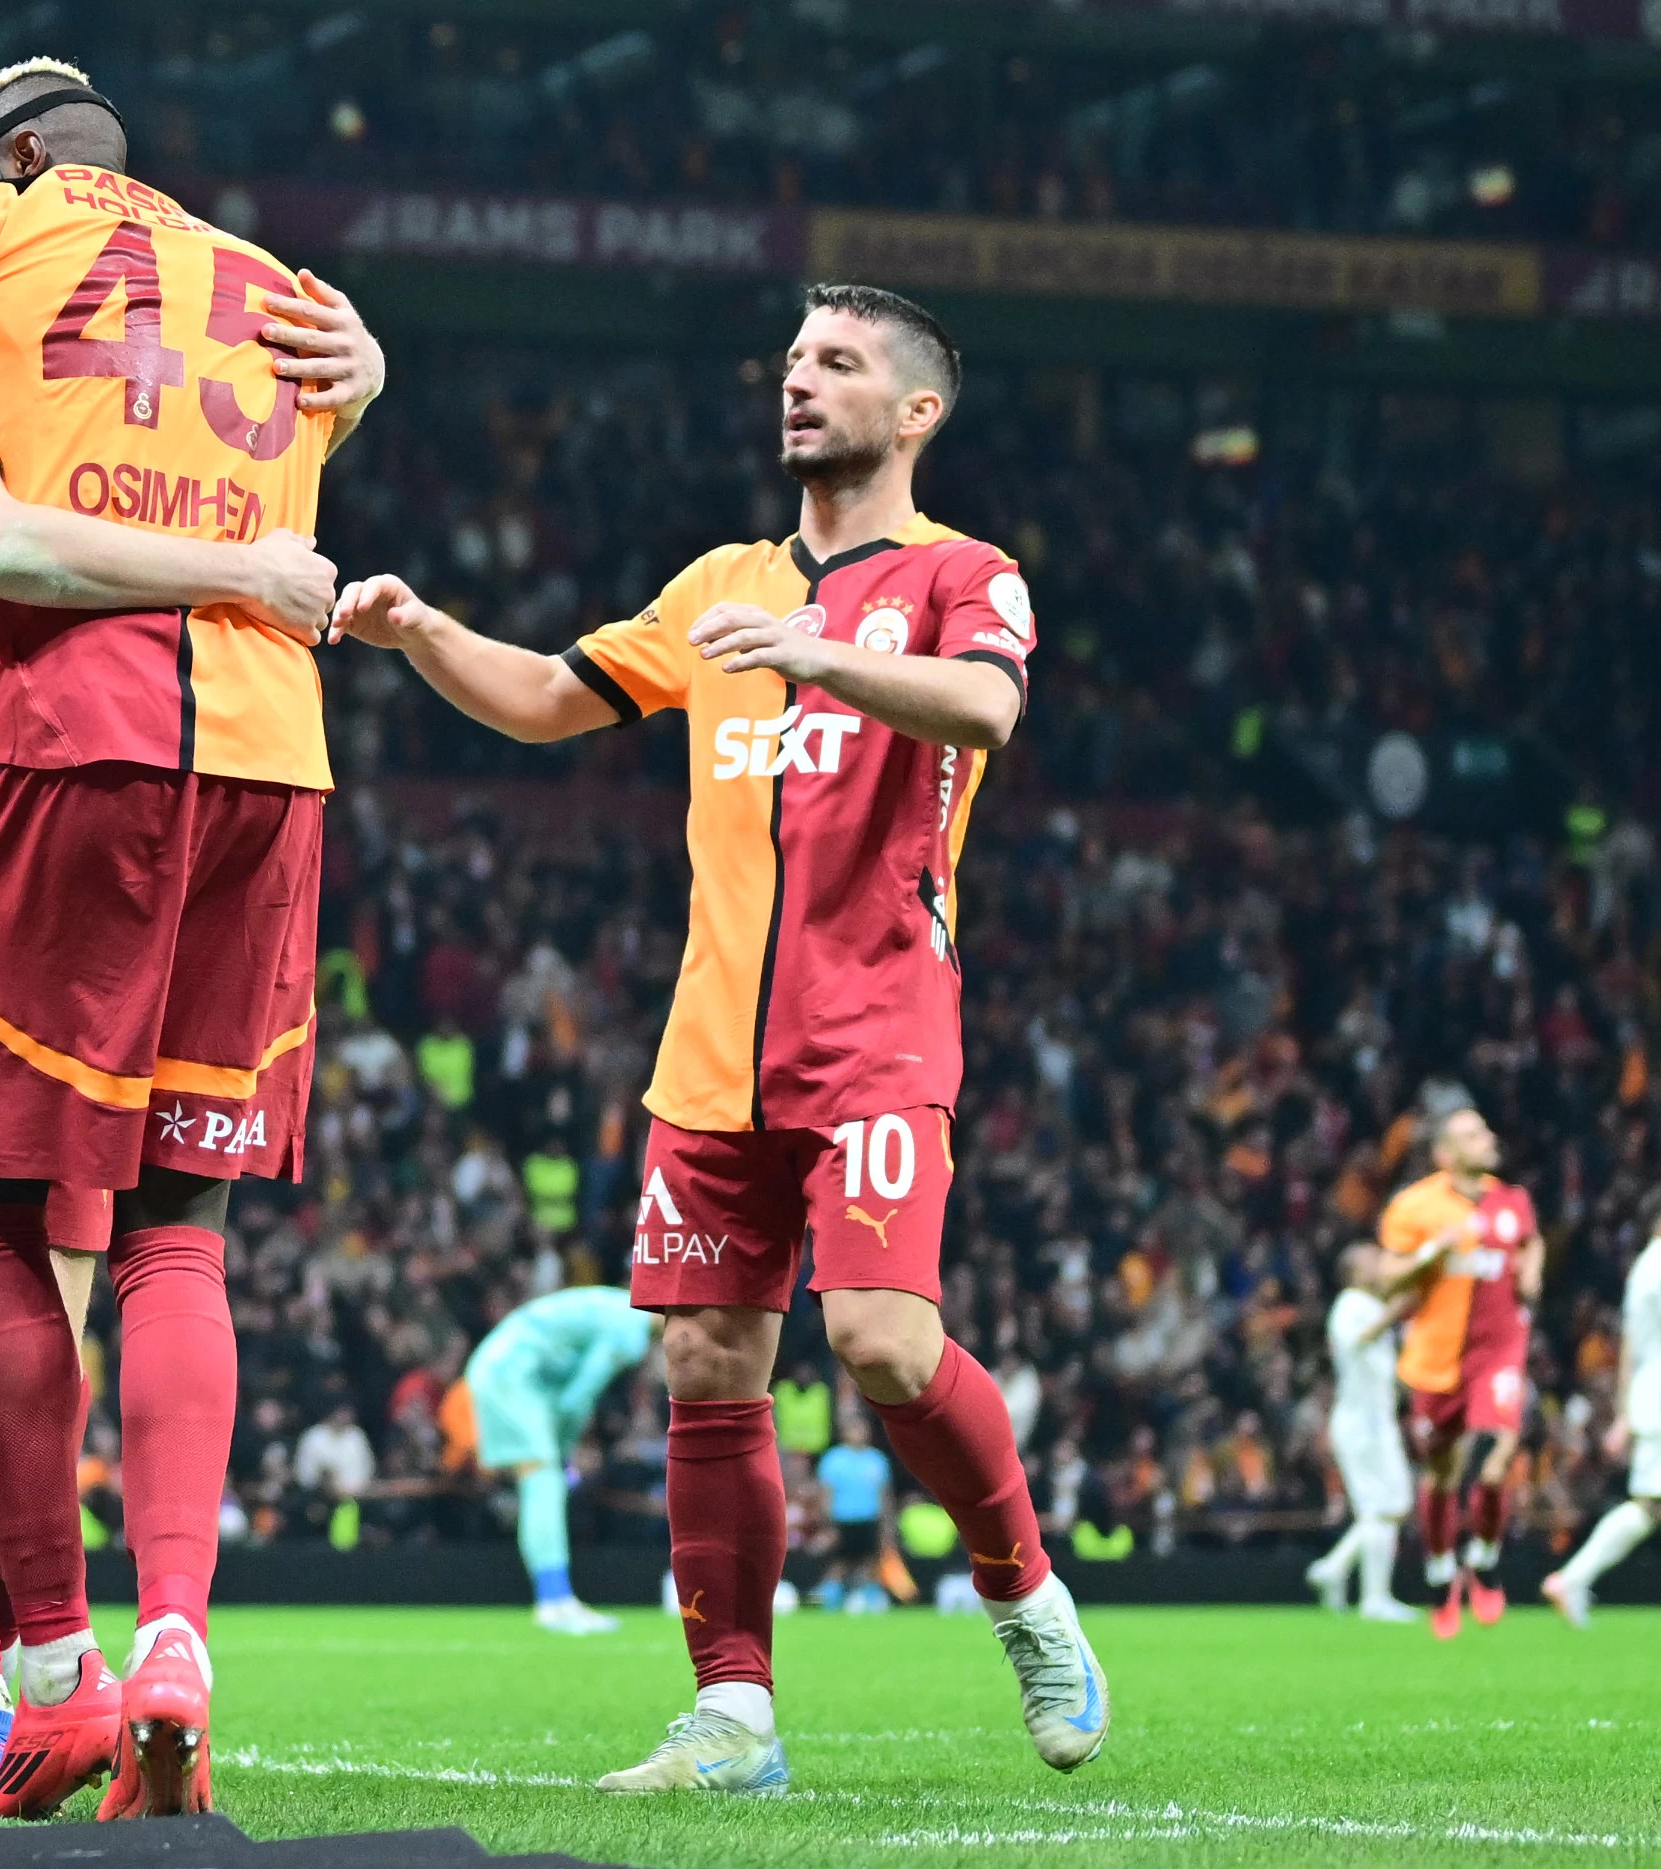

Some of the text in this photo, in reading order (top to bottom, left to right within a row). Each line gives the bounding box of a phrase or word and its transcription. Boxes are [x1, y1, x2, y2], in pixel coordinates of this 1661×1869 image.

[398, 195, 578, 261] RAMS
[594, 204, 765, 269] PARK
[42, 221, 300, 461] 45
[69, 462, 267, 545] OSIMHEN
[833, 1113, 915, 1200] 10
